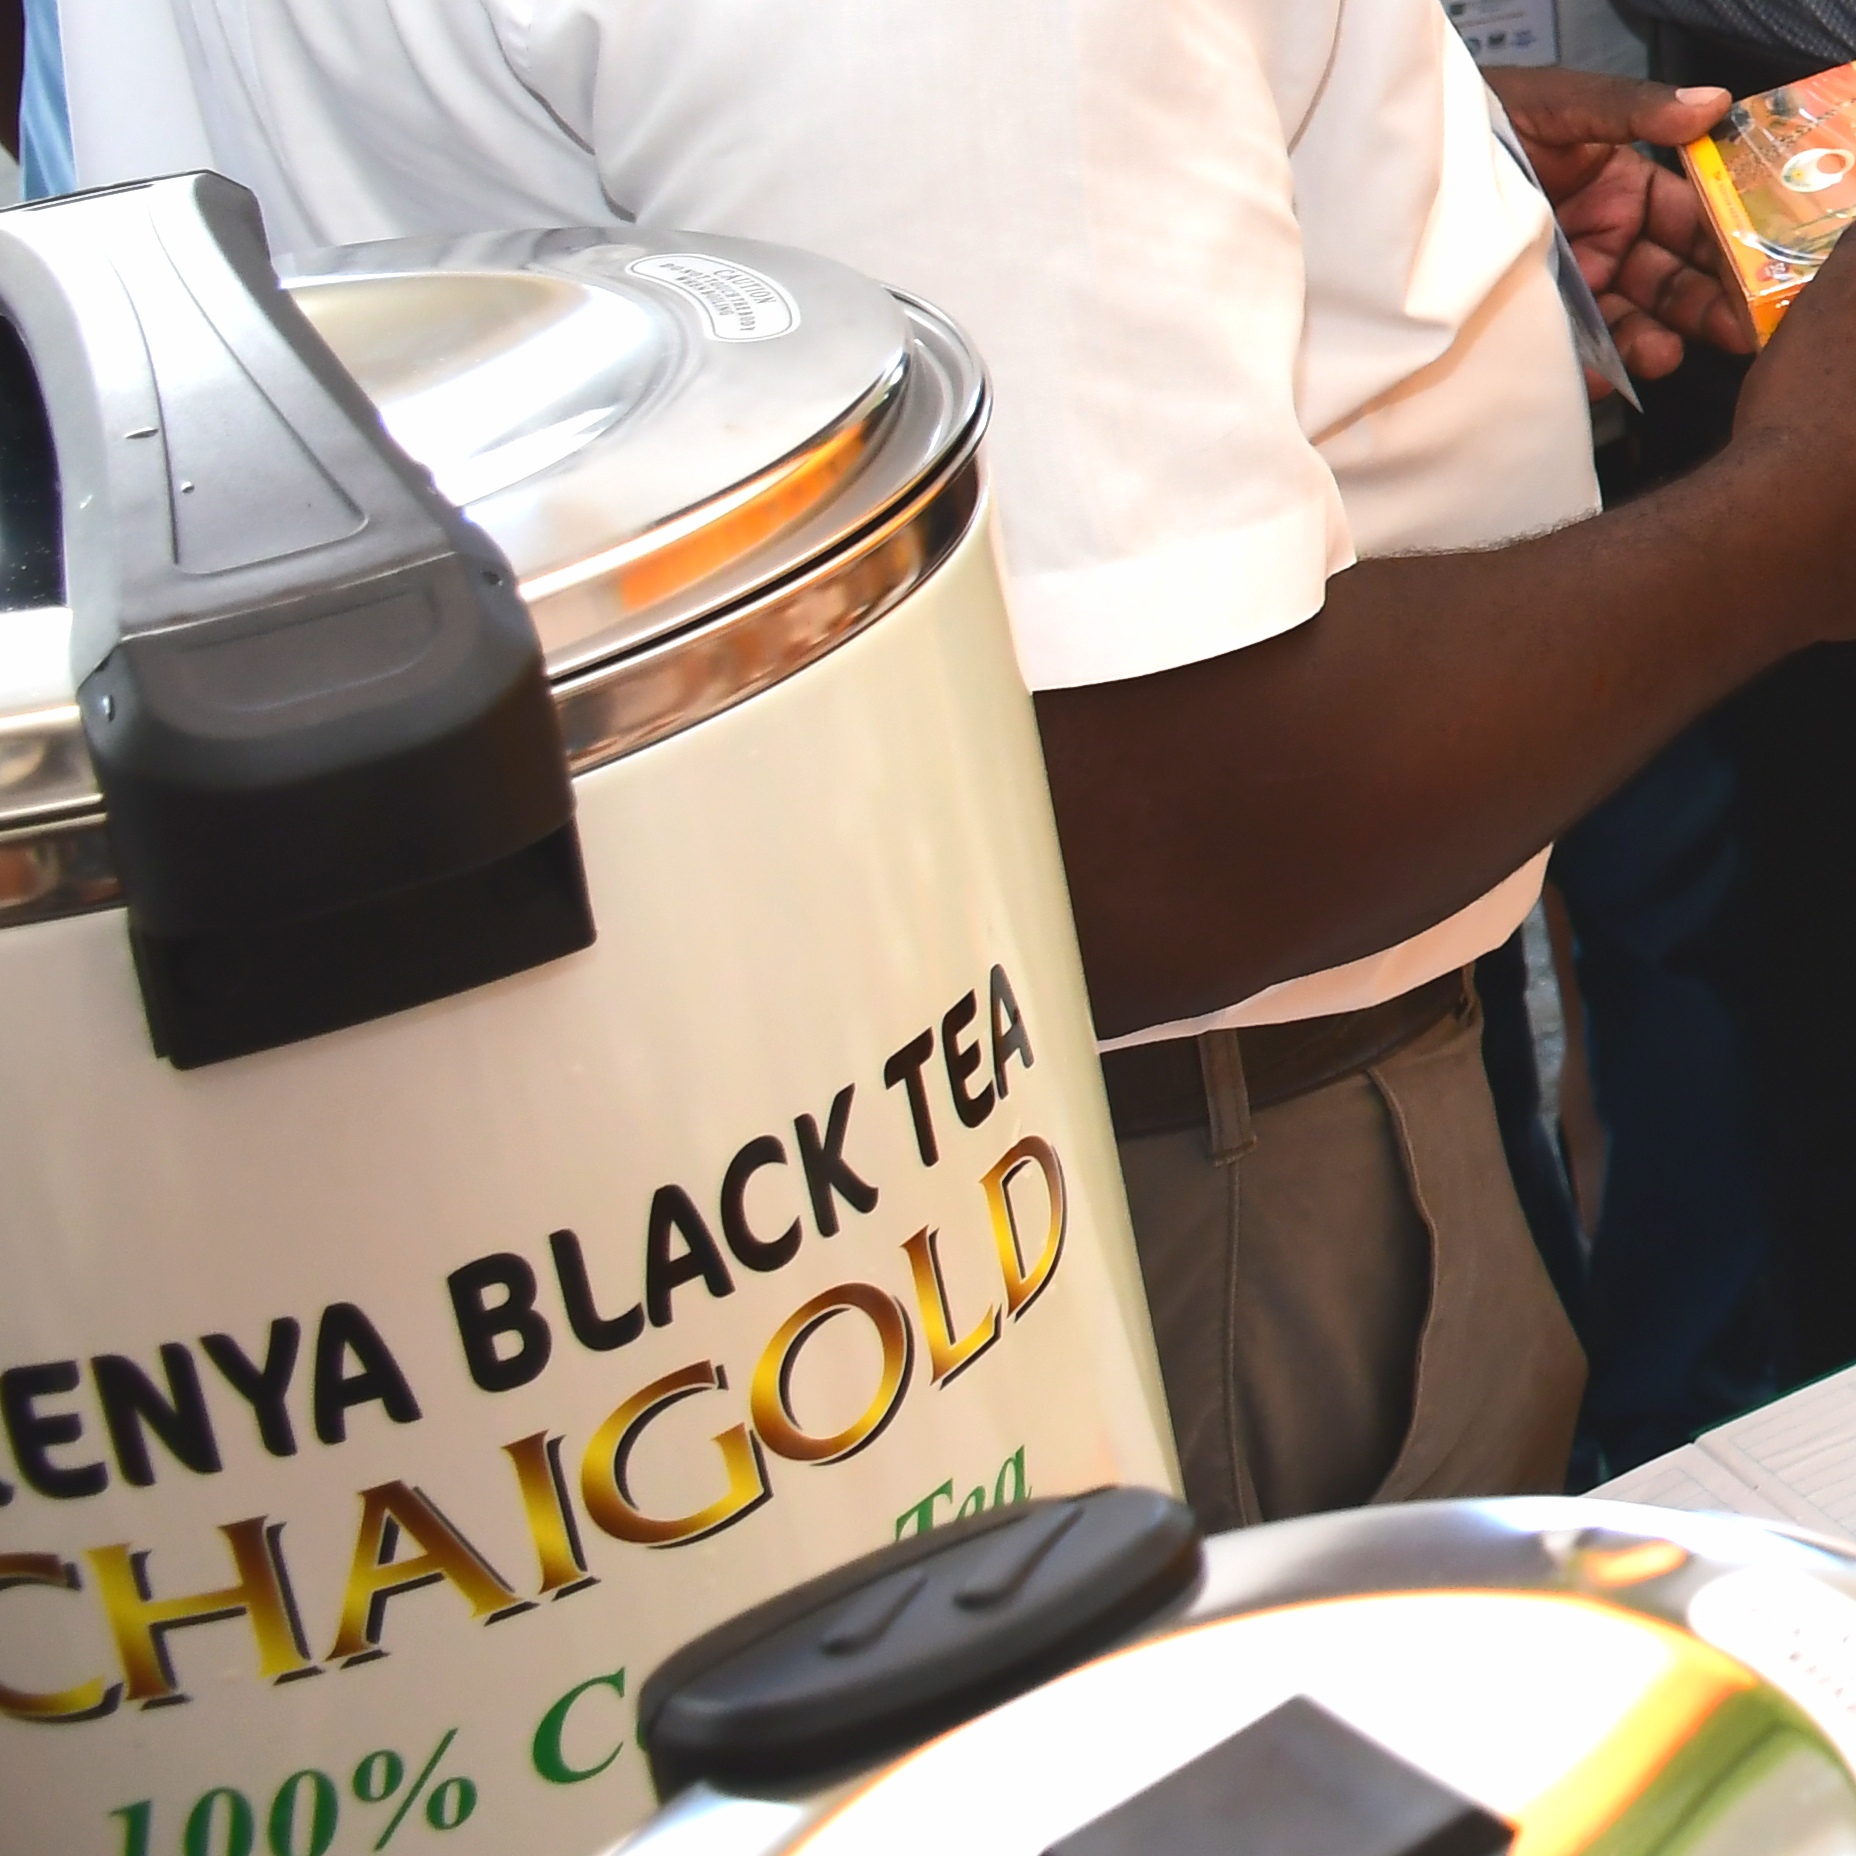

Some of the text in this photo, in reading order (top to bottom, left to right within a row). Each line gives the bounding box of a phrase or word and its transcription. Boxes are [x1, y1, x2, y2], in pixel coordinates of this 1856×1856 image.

[0, 962, 1034, 1508] ENYA BLACK TEA
[0, 1132, 1068, 1724] CHAIGOLD
[109, 1726, 478, 1856] 100%
